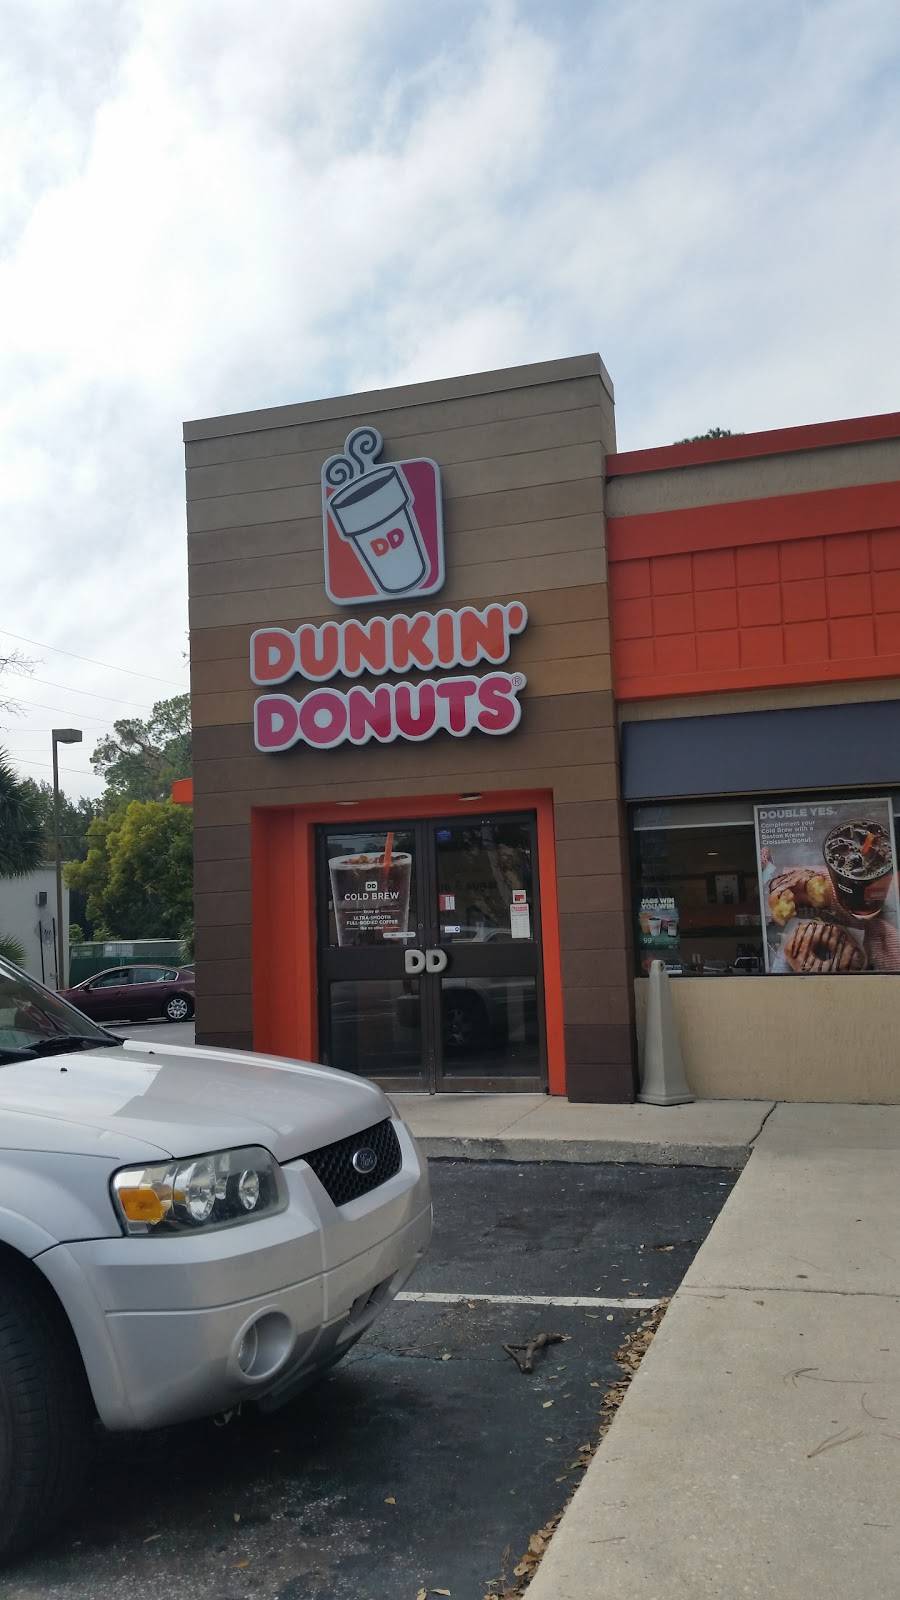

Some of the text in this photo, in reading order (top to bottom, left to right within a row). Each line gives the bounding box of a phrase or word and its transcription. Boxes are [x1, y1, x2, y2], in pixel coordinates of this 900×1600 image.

[370, 528, 404, 556] DD
[253, 605, 524, 681] DUNKIN'
[257, 677, 516, 748] DONUTS
[760, 807, 837, 819] DOUBLE YES.
[344, 892, 399, 901] COLD BREW
[405, 949, 447, 974] DD
